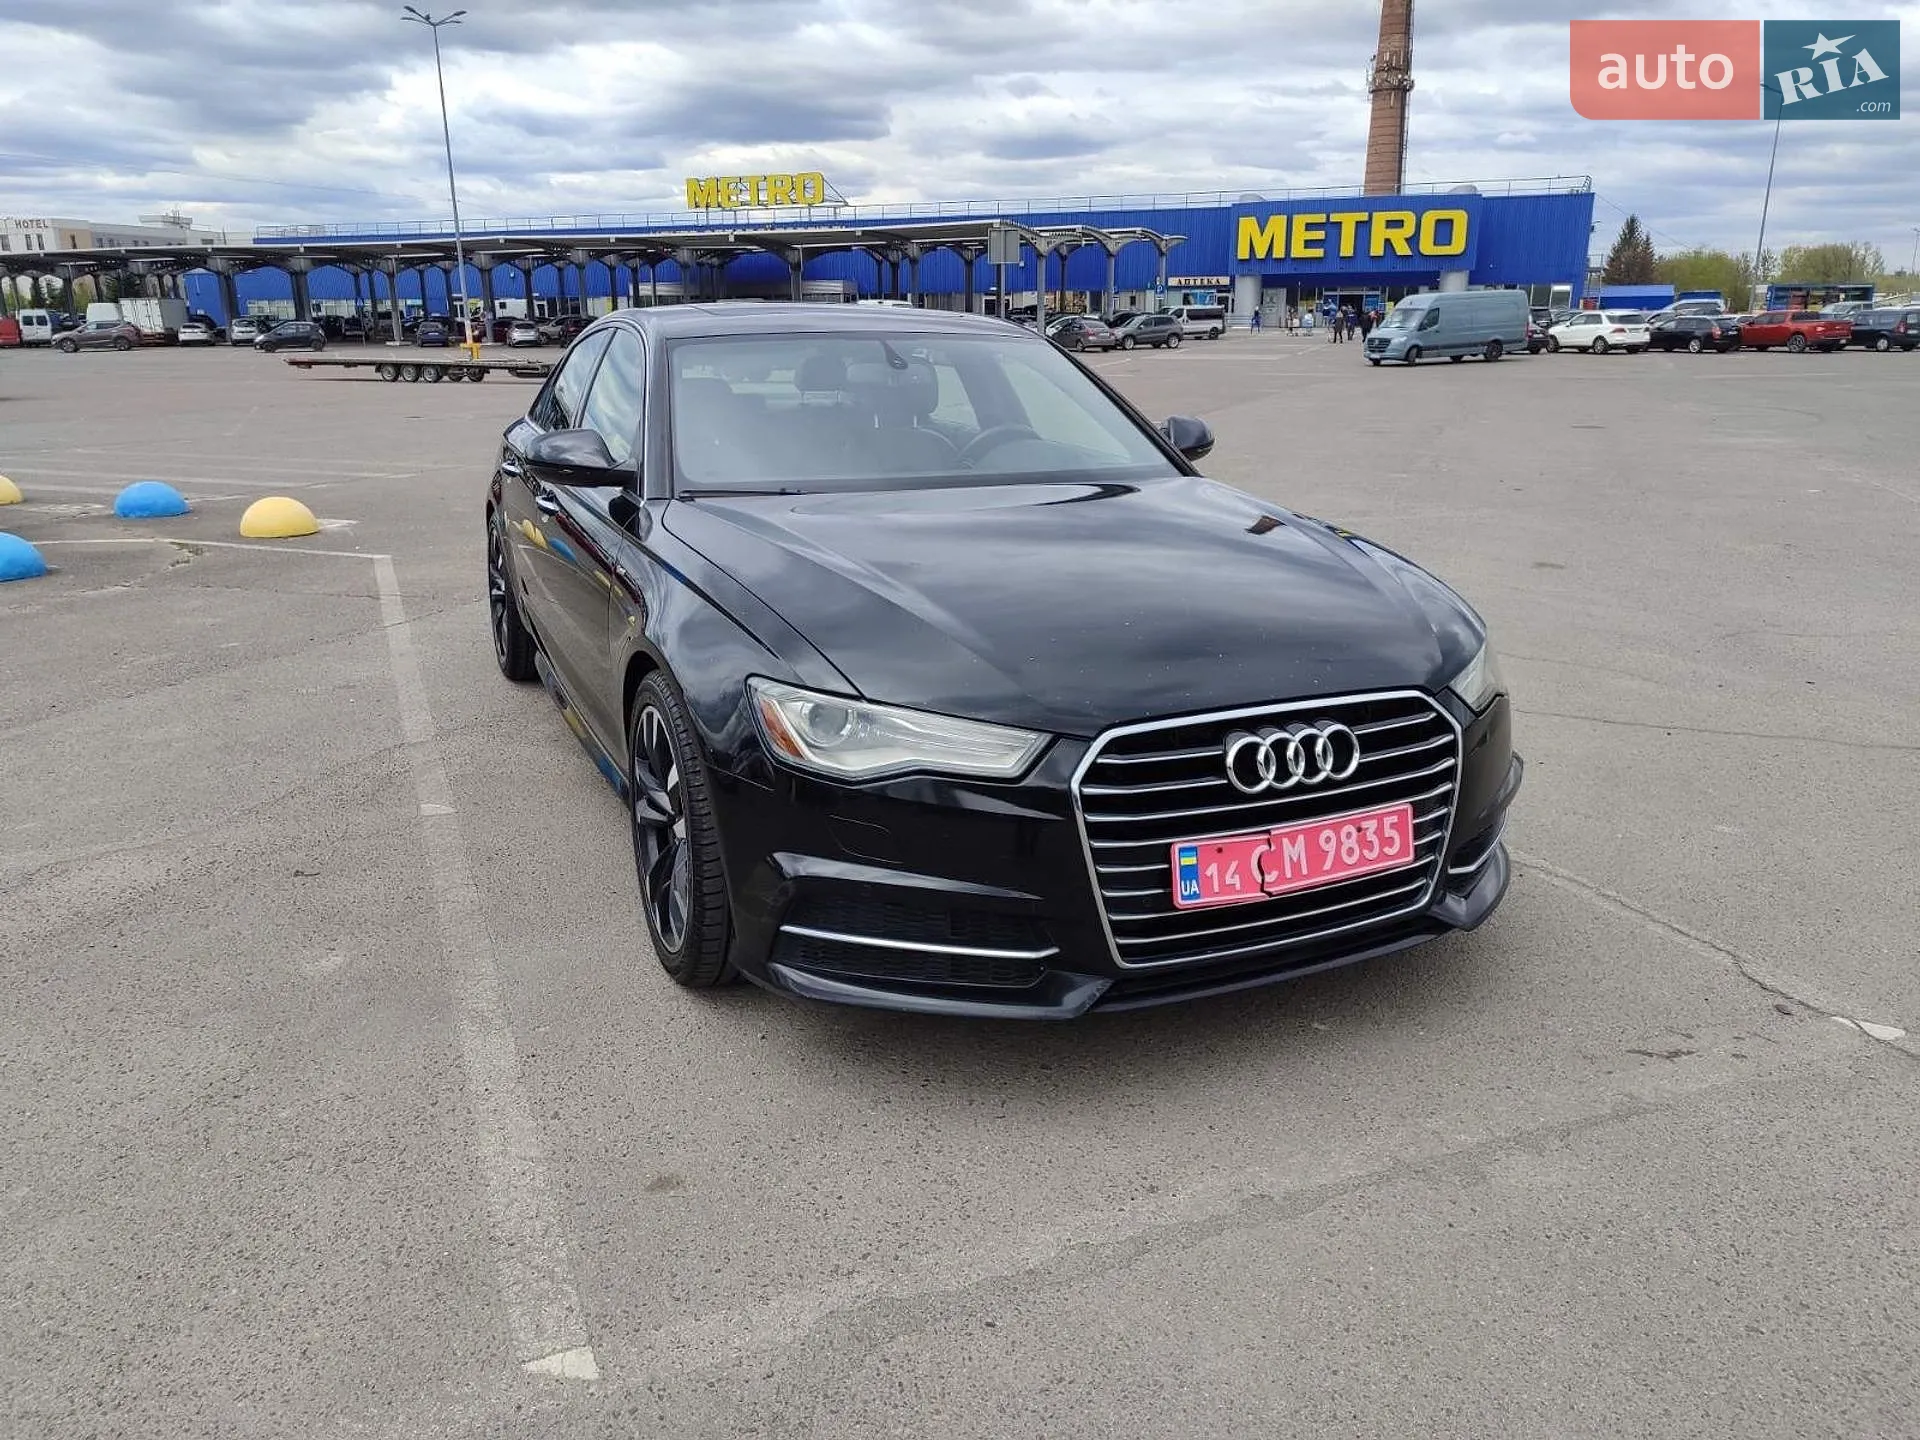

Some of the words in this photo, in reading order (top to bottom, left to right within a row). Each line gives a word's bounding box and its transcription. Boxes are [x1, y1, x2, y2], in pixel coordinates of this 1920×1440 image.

[686, 171, 825, 209] METRO
[14, 218, 49, 229] HOTEL
[1236, 209, 1468, 261] METRO
[1176, 277, 1222, 286] АПТЕКА
[1204, 860, 1241, 893] 14
[1250, 834, 1308, 883] CM
[1318, 815, 1402, 871] 9835
[1180, 879, 1200, 896] UA
